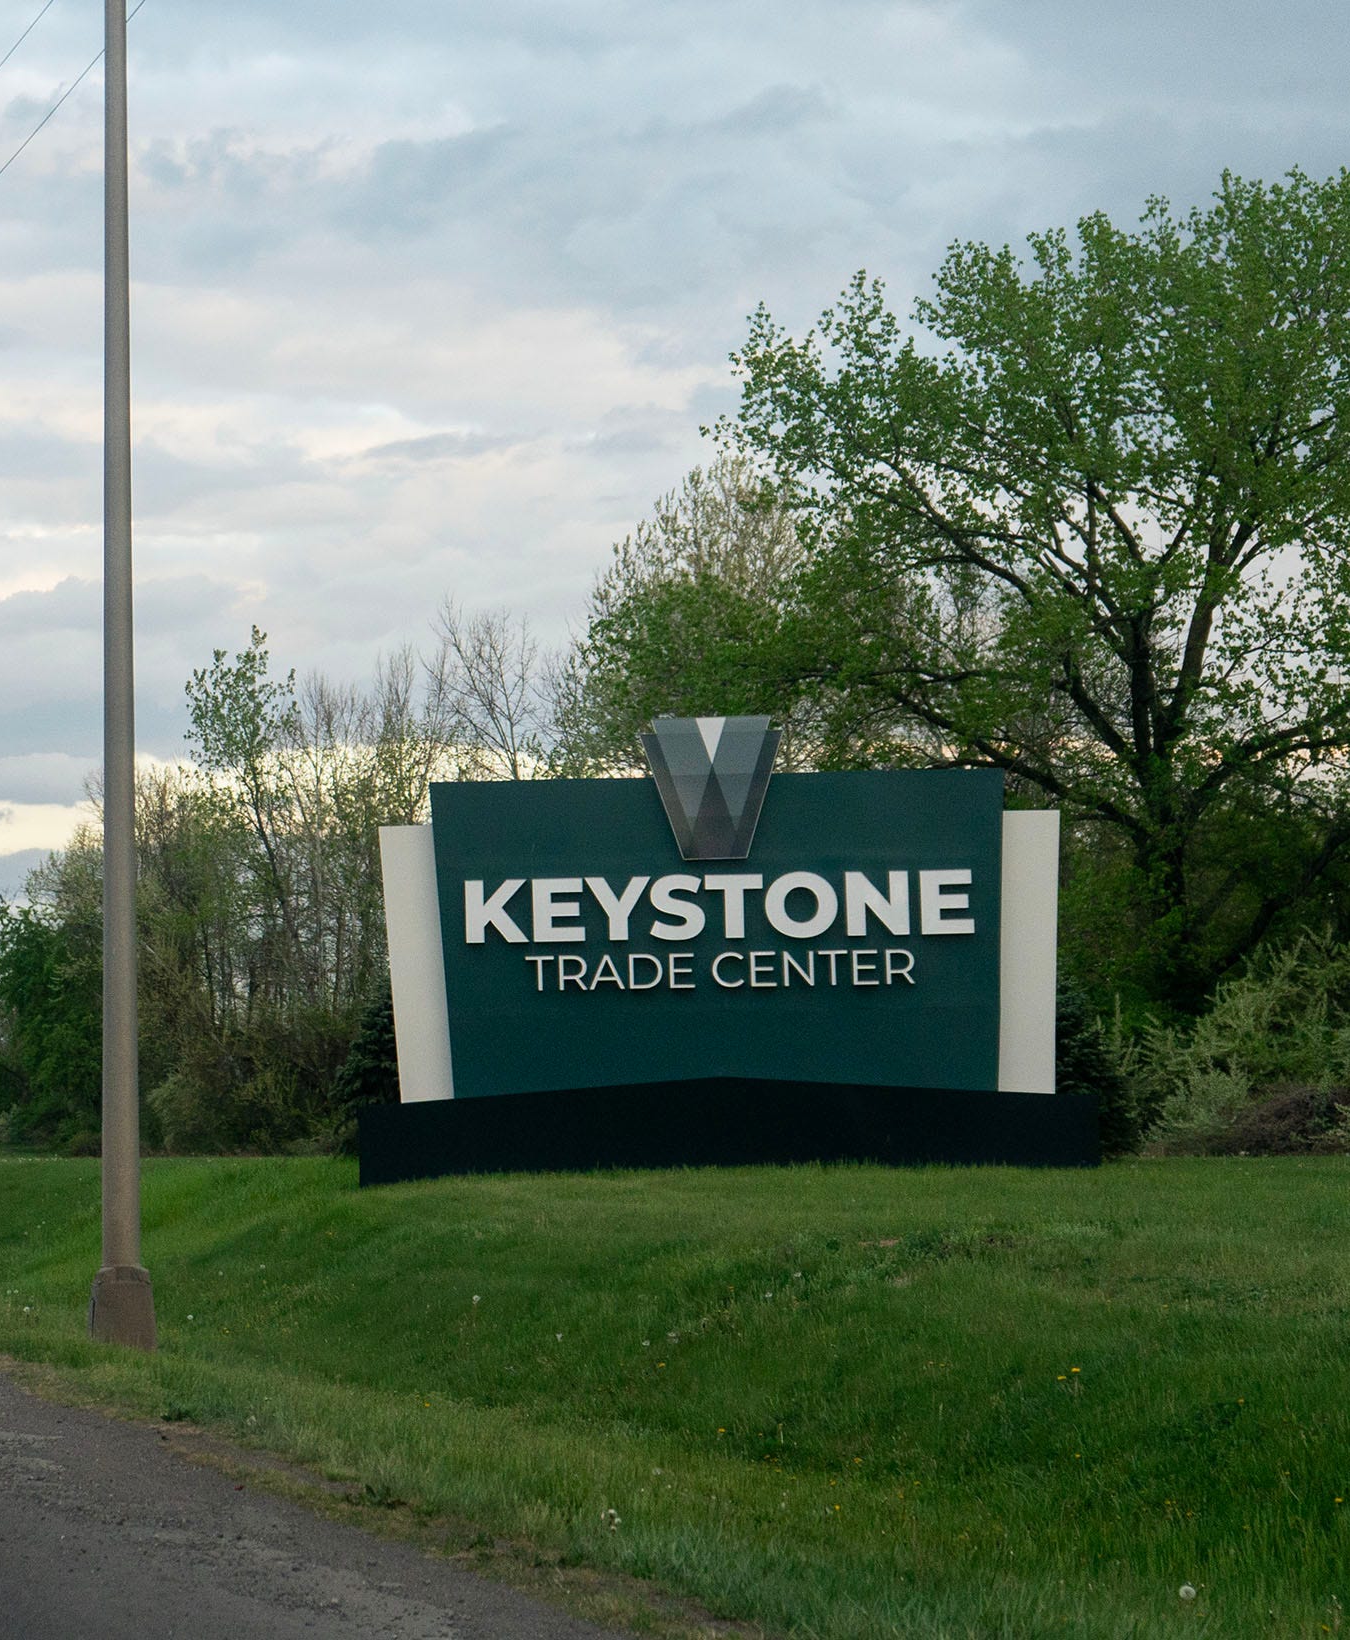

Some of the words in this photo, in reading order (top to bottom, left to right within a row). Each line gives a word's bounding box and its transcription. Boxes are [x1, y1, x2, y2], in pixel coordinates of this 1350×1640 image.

[464, 868, 976, 945] KEYSTONE
[525, 951, 697, 992] TRADE
[711, 948, 916, 989] CENTER
